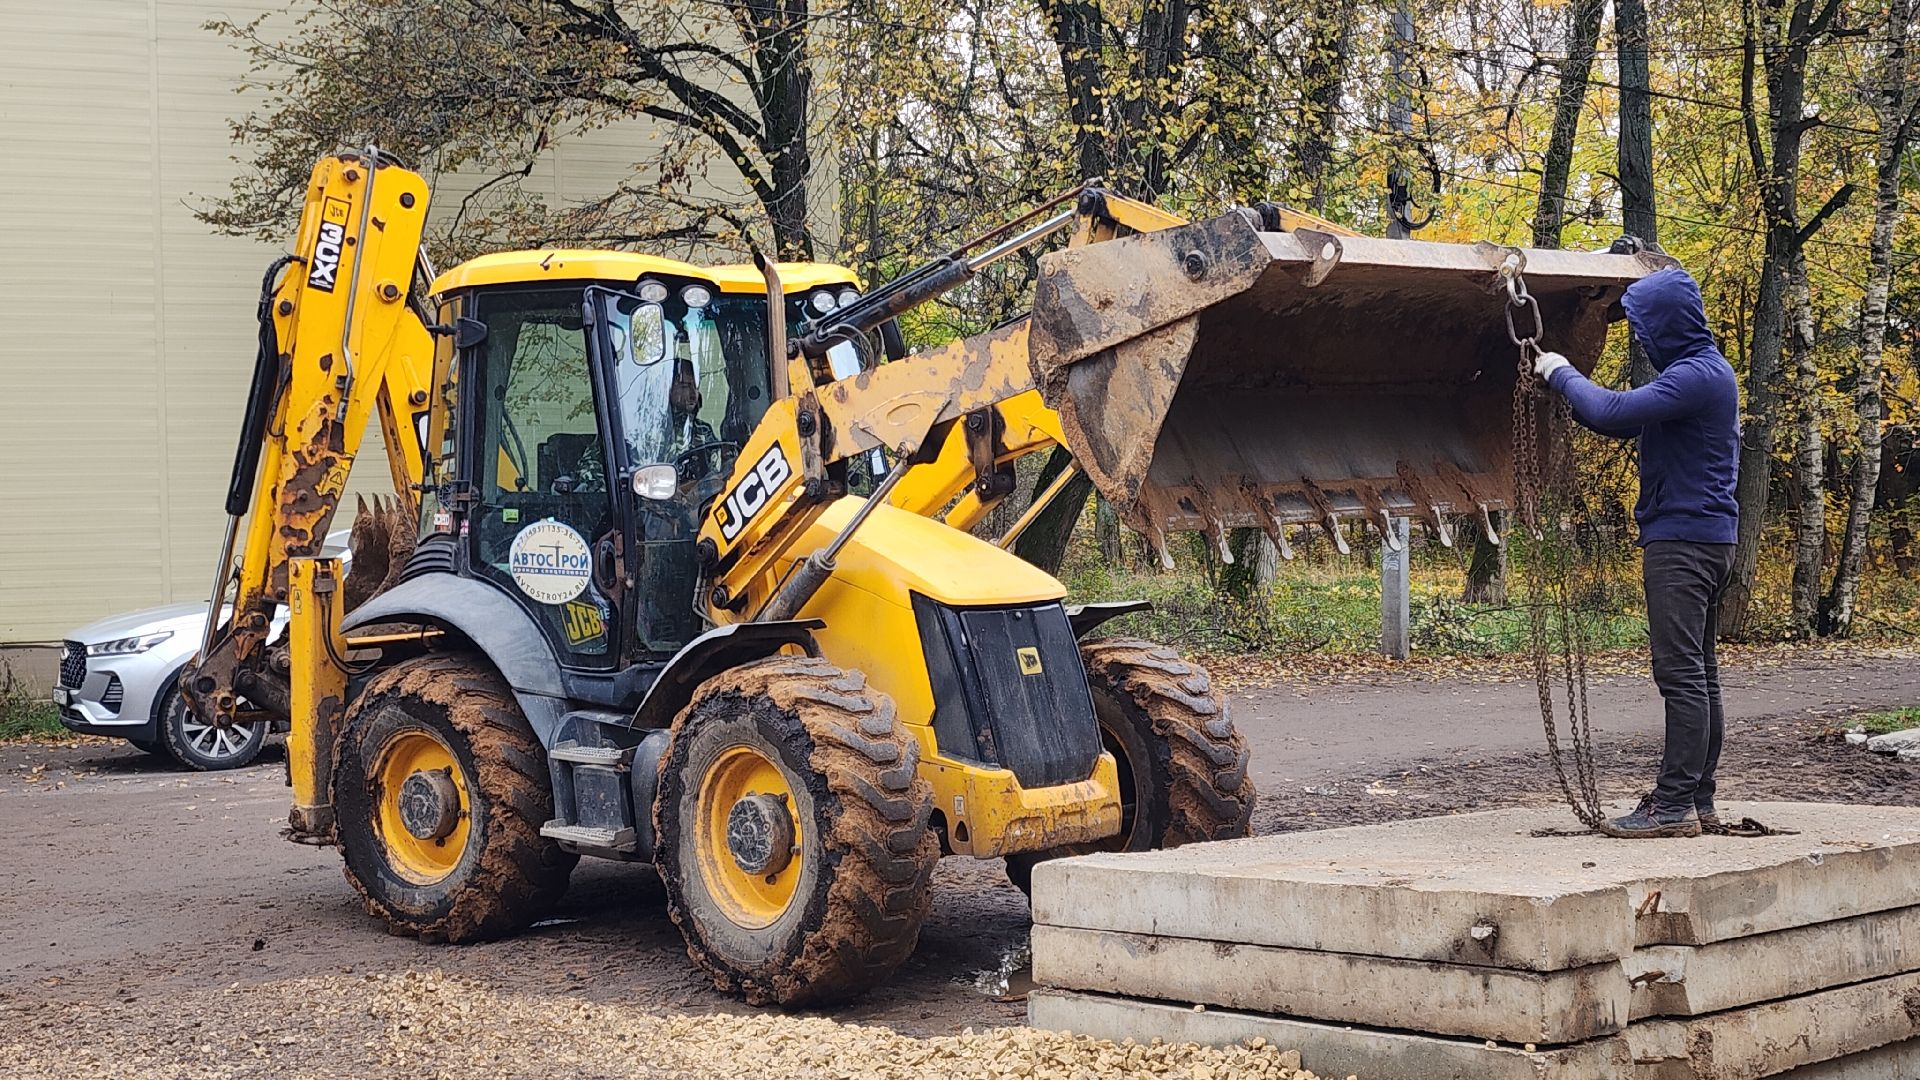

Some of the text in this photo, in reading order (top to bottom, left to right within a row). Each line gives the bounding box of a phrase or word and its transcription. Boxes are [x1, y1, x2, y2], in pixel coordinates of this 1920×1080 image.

[310, 222, 344, 284] 3CX
[722, 447, 789, 539] JCB
[513, 545, 588, 568] АВТОСТРОЙ
[516, 575, 585, 601] AVTOSTROY24.RU
[566, 603, 603, 640] JCB
